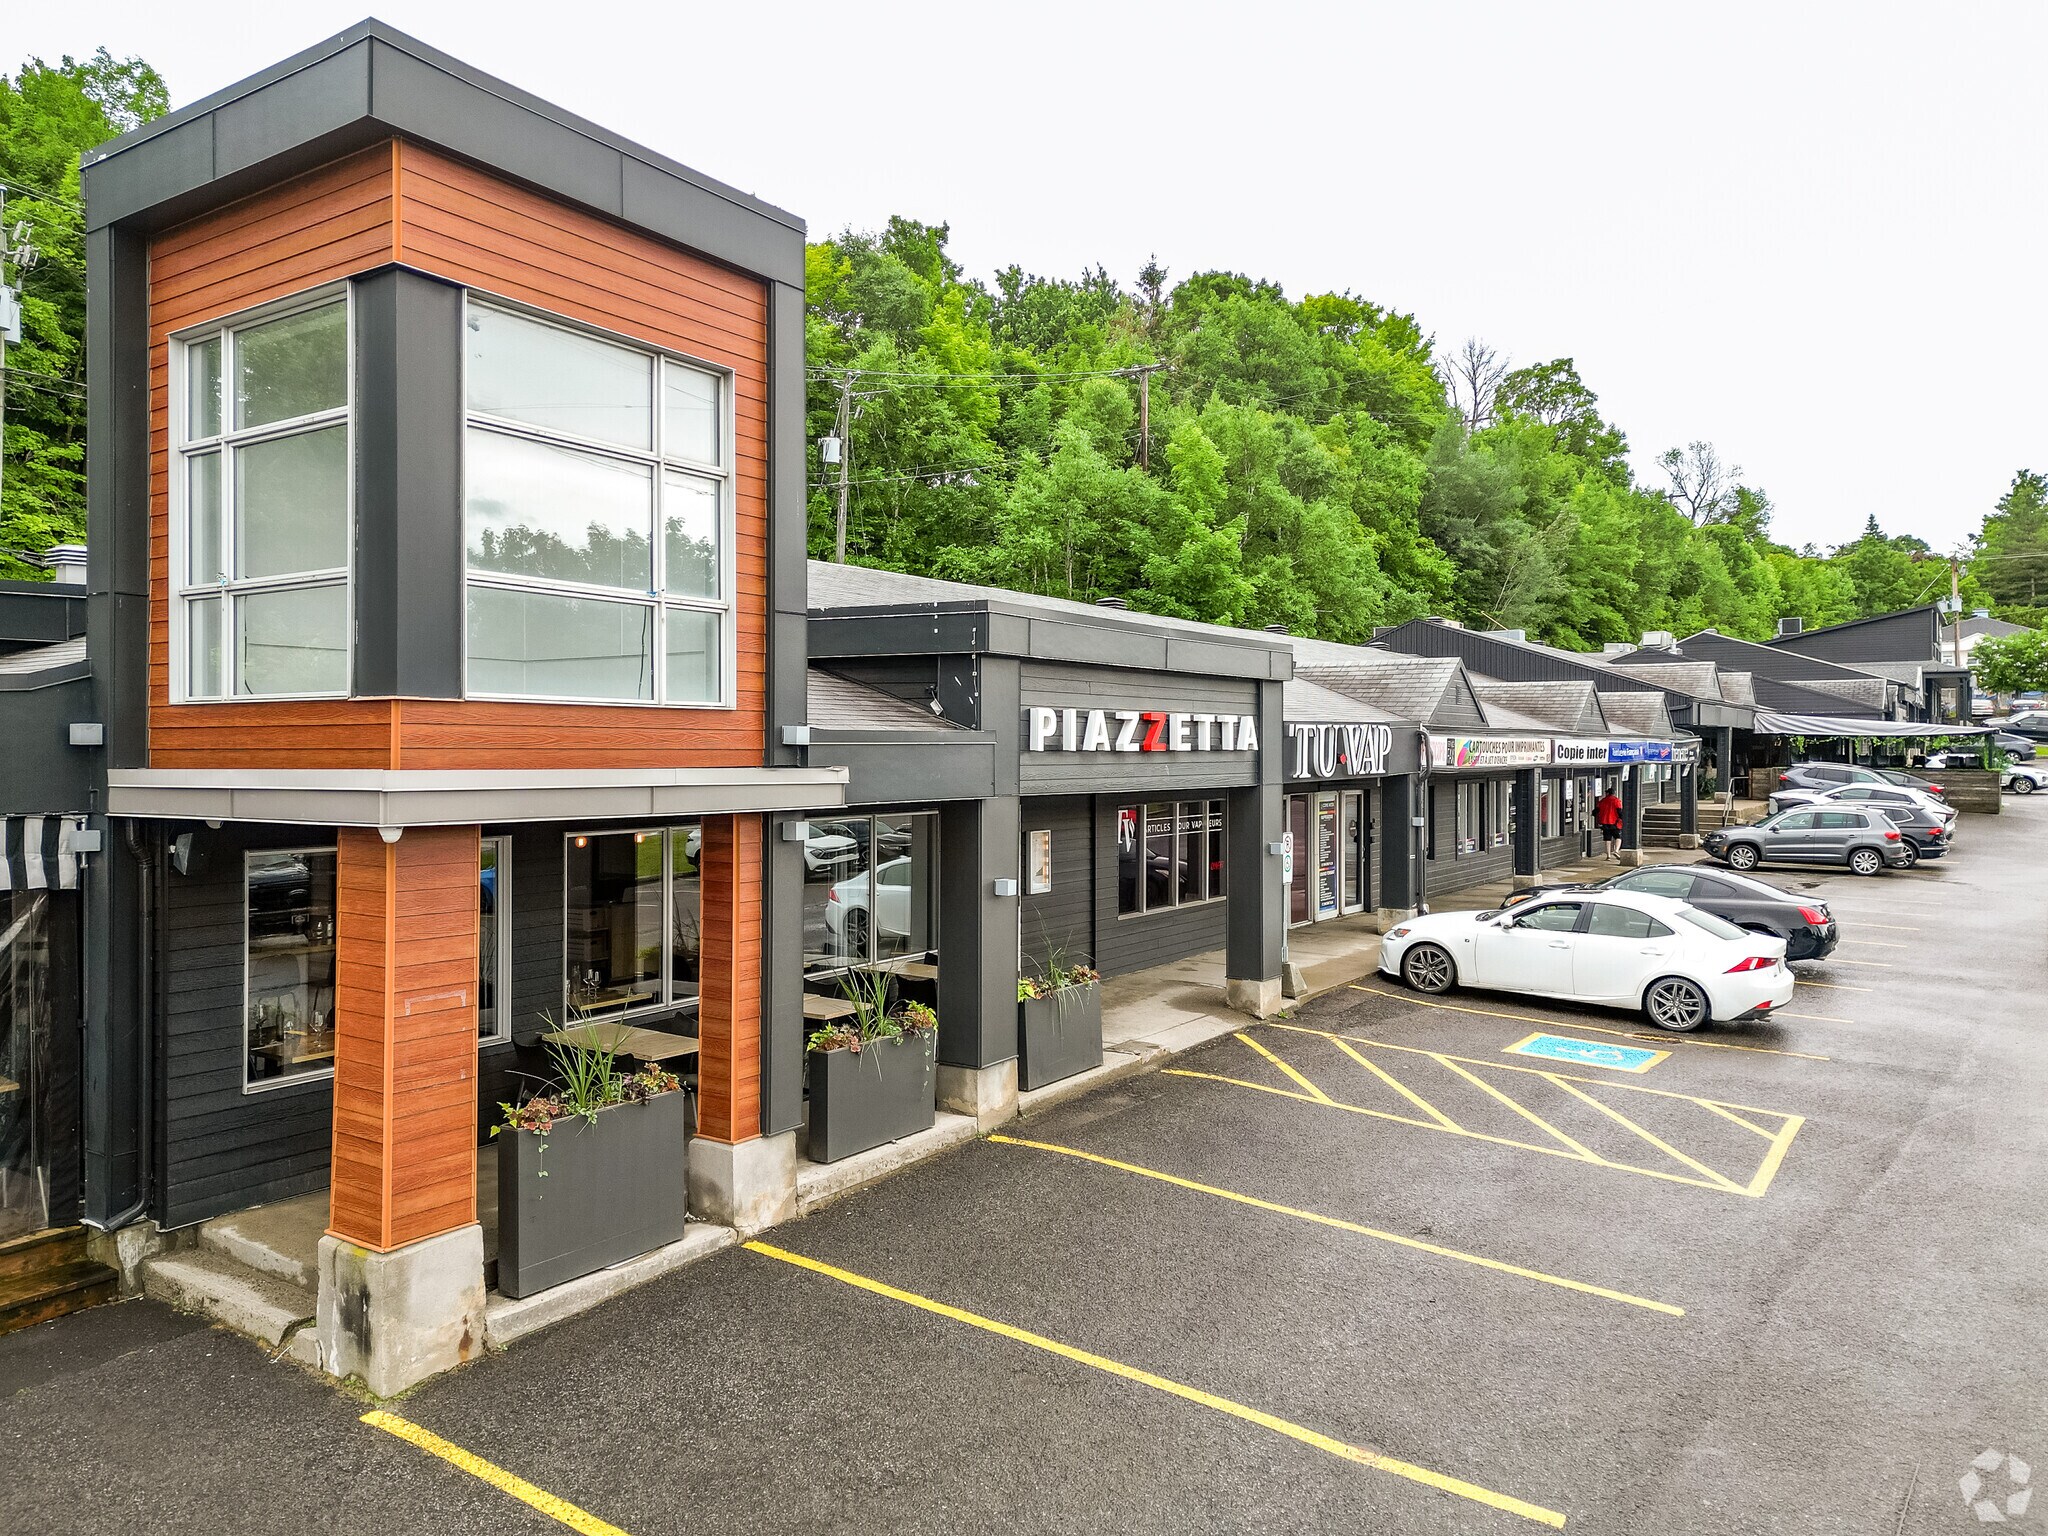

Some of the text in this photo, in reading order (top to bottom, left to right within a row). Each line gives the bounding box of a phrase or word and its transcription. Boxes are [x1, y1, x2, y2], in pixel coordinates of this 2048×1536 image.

[1029, 707, 1259, 752] PIAZZETTA
[1469, 740, 1501, 754] CARTOUCHES
[1502, 741, 1515, 754] POUR
[1557, 744, 1585, 760] Copie
[1586, 746, 1608, 760] inter
[1146, 823, 1171, 833] RTICLES
[1178, 821, 1190, 830] OUR
